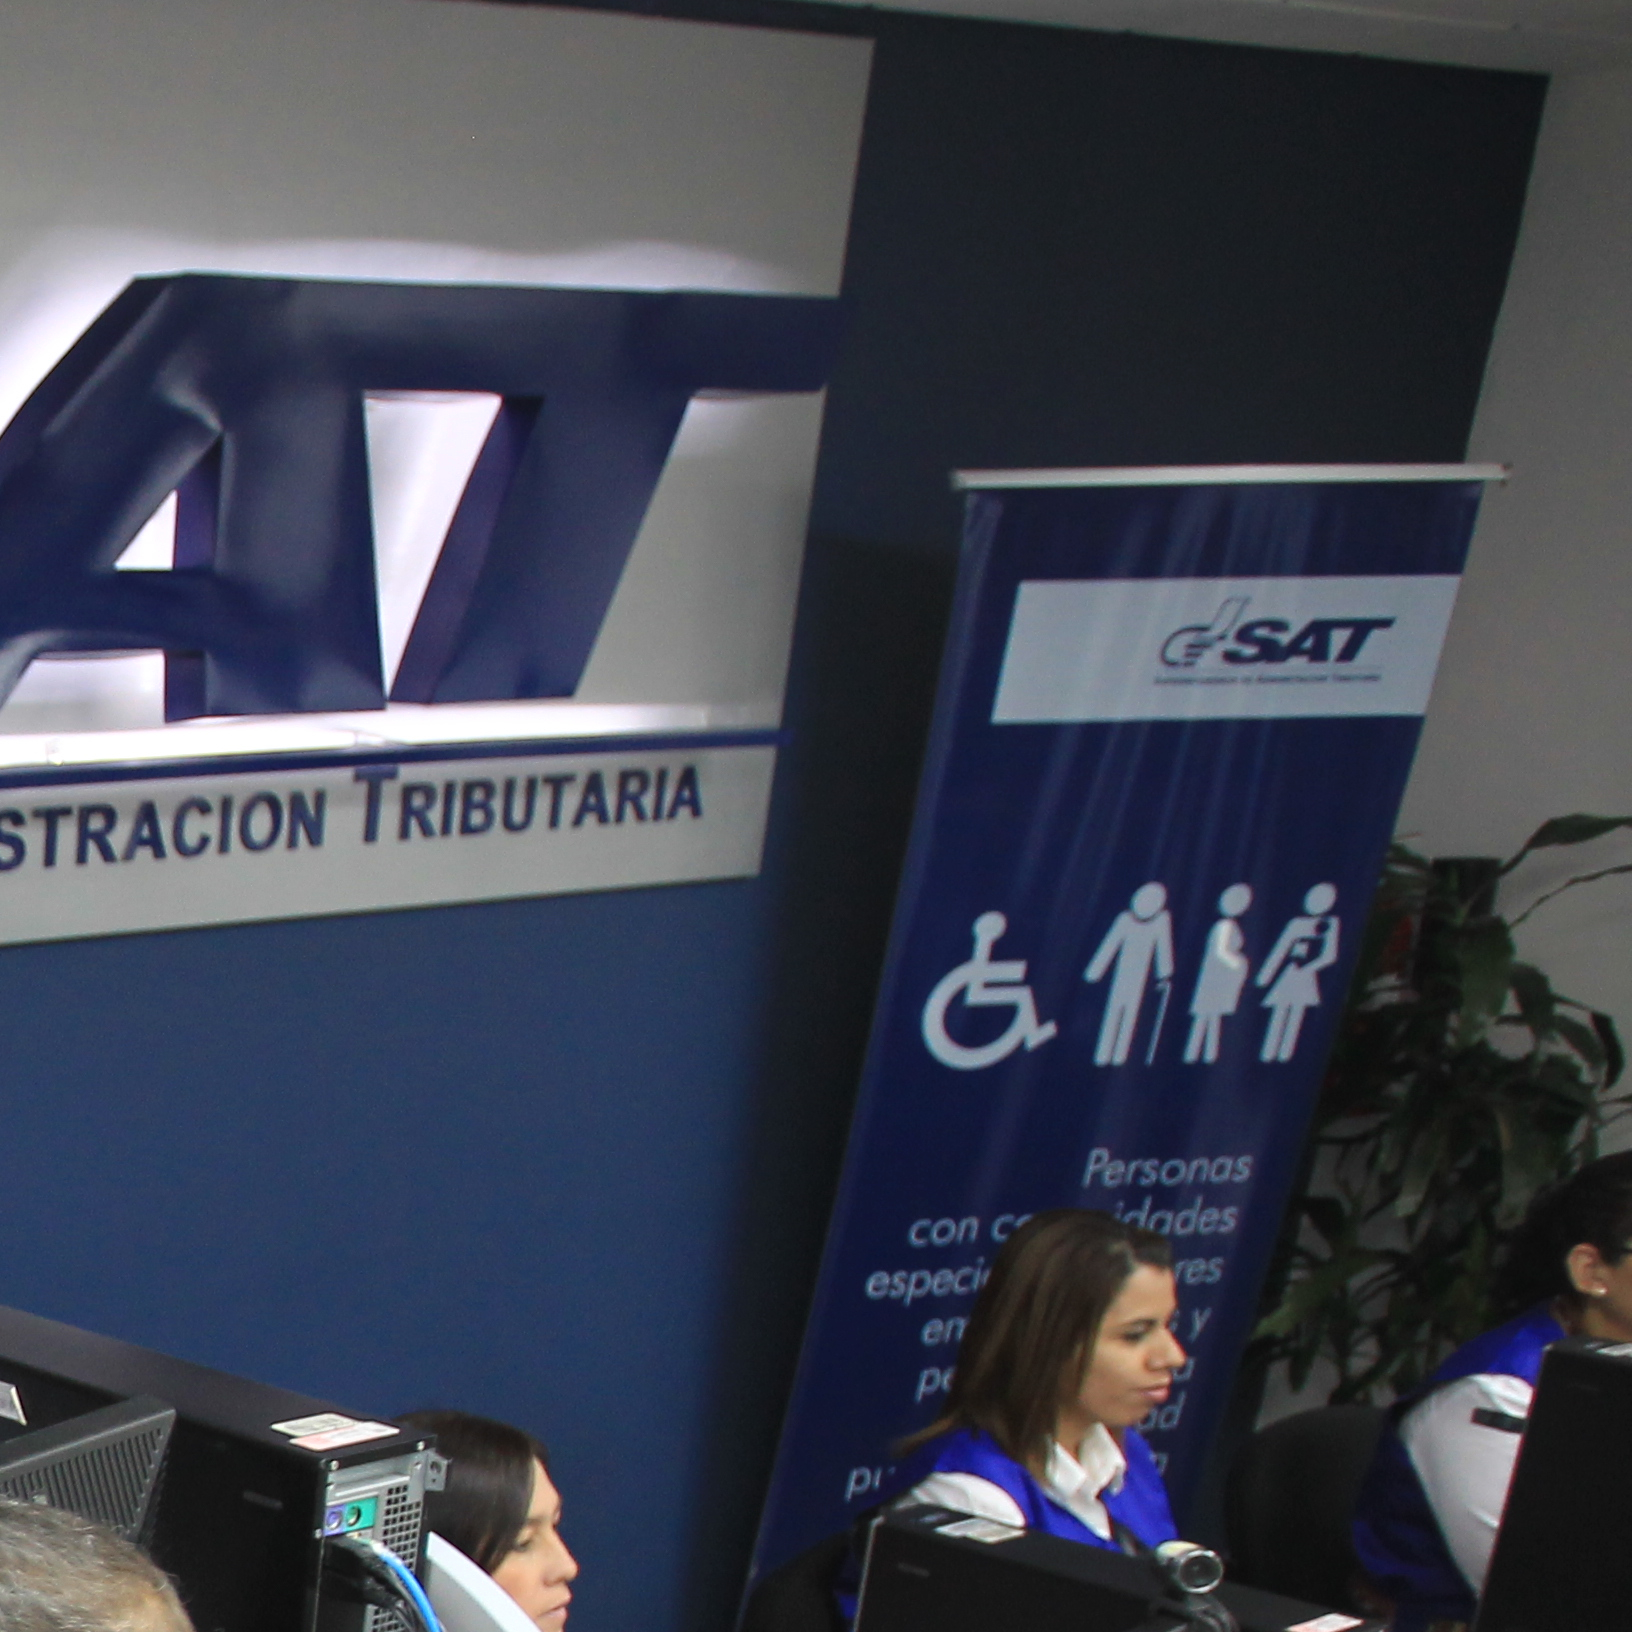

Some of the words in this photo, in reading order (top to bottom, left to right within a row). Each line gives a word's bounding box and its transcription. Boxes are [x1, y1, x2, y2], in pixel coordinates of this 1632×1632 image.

[1223, 616, 1396, 665] SAT
[354, 764, 703, 846] TRIBUTARIA
[1081, 1147, 1253, 1188] Personas
[908, 1215, 979, 1248] con
